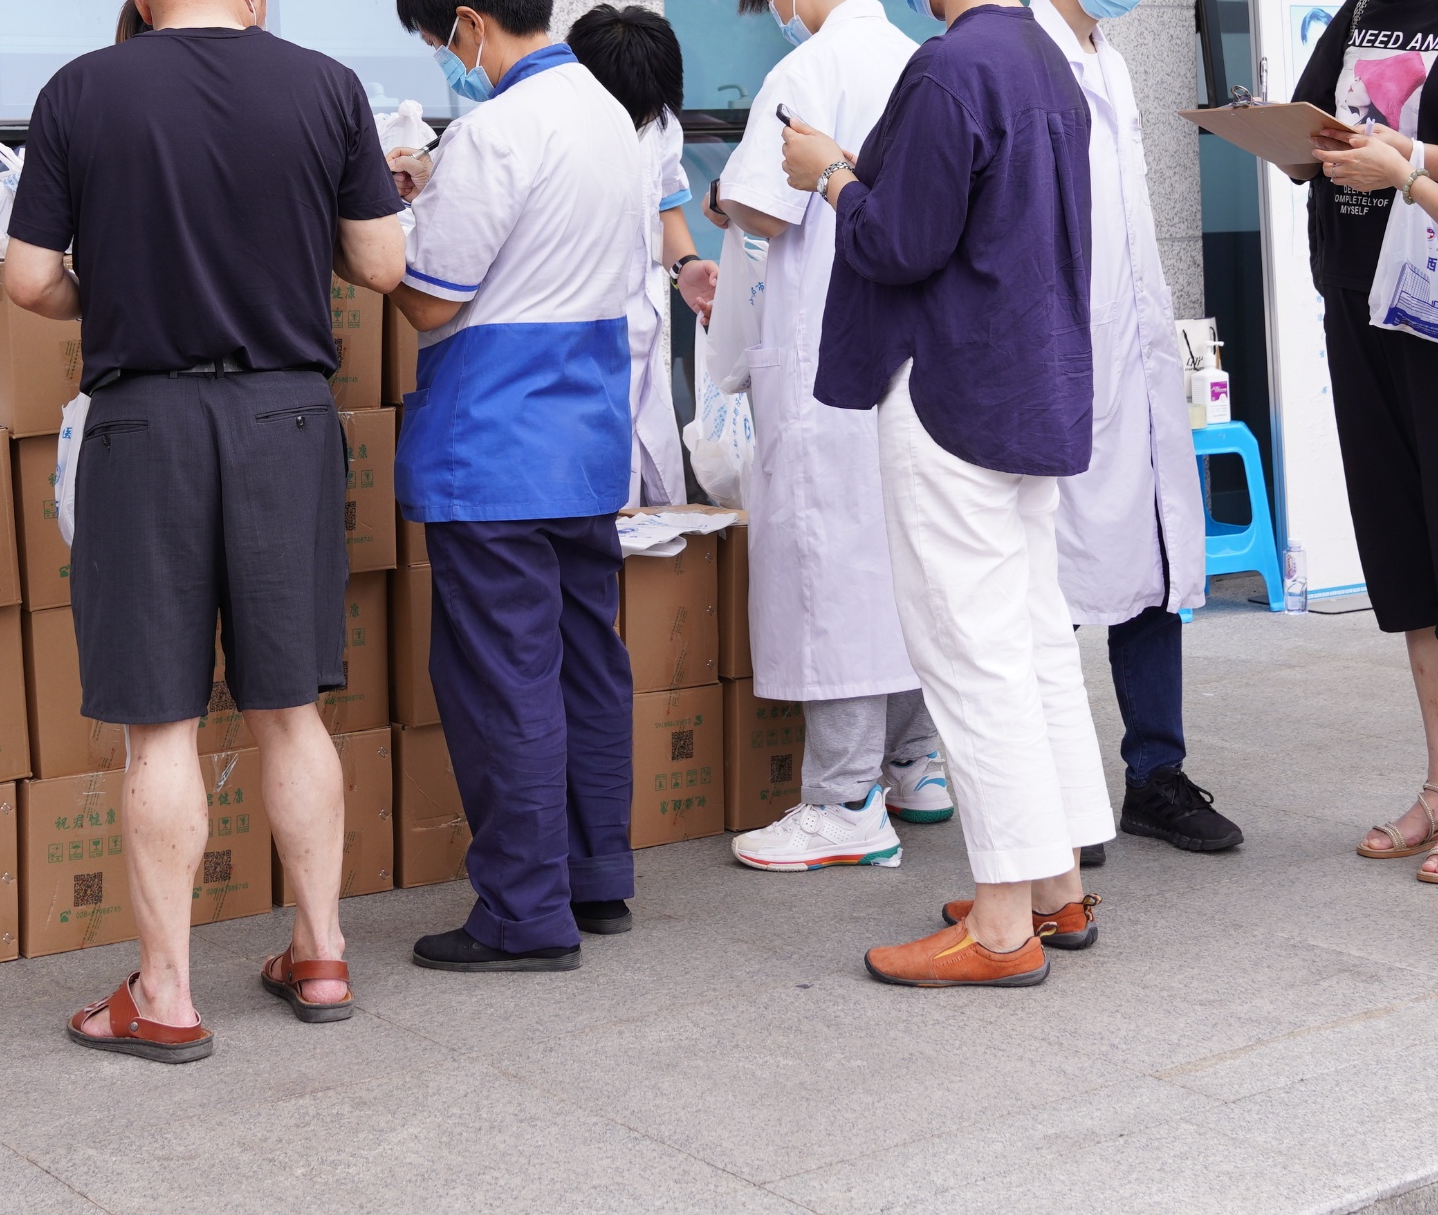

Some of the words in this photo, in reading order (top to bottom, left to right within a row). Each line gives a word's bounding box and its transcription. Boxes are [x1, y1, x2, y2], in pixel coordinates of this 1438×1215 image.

[1348, 29, 1404, 48] NEED
[1334, 194, 1390, 207] OMPLETELYOF
[1339, 205, 1369, 216] MYSELF
[55, 808, 118, 830] 祝君健康
